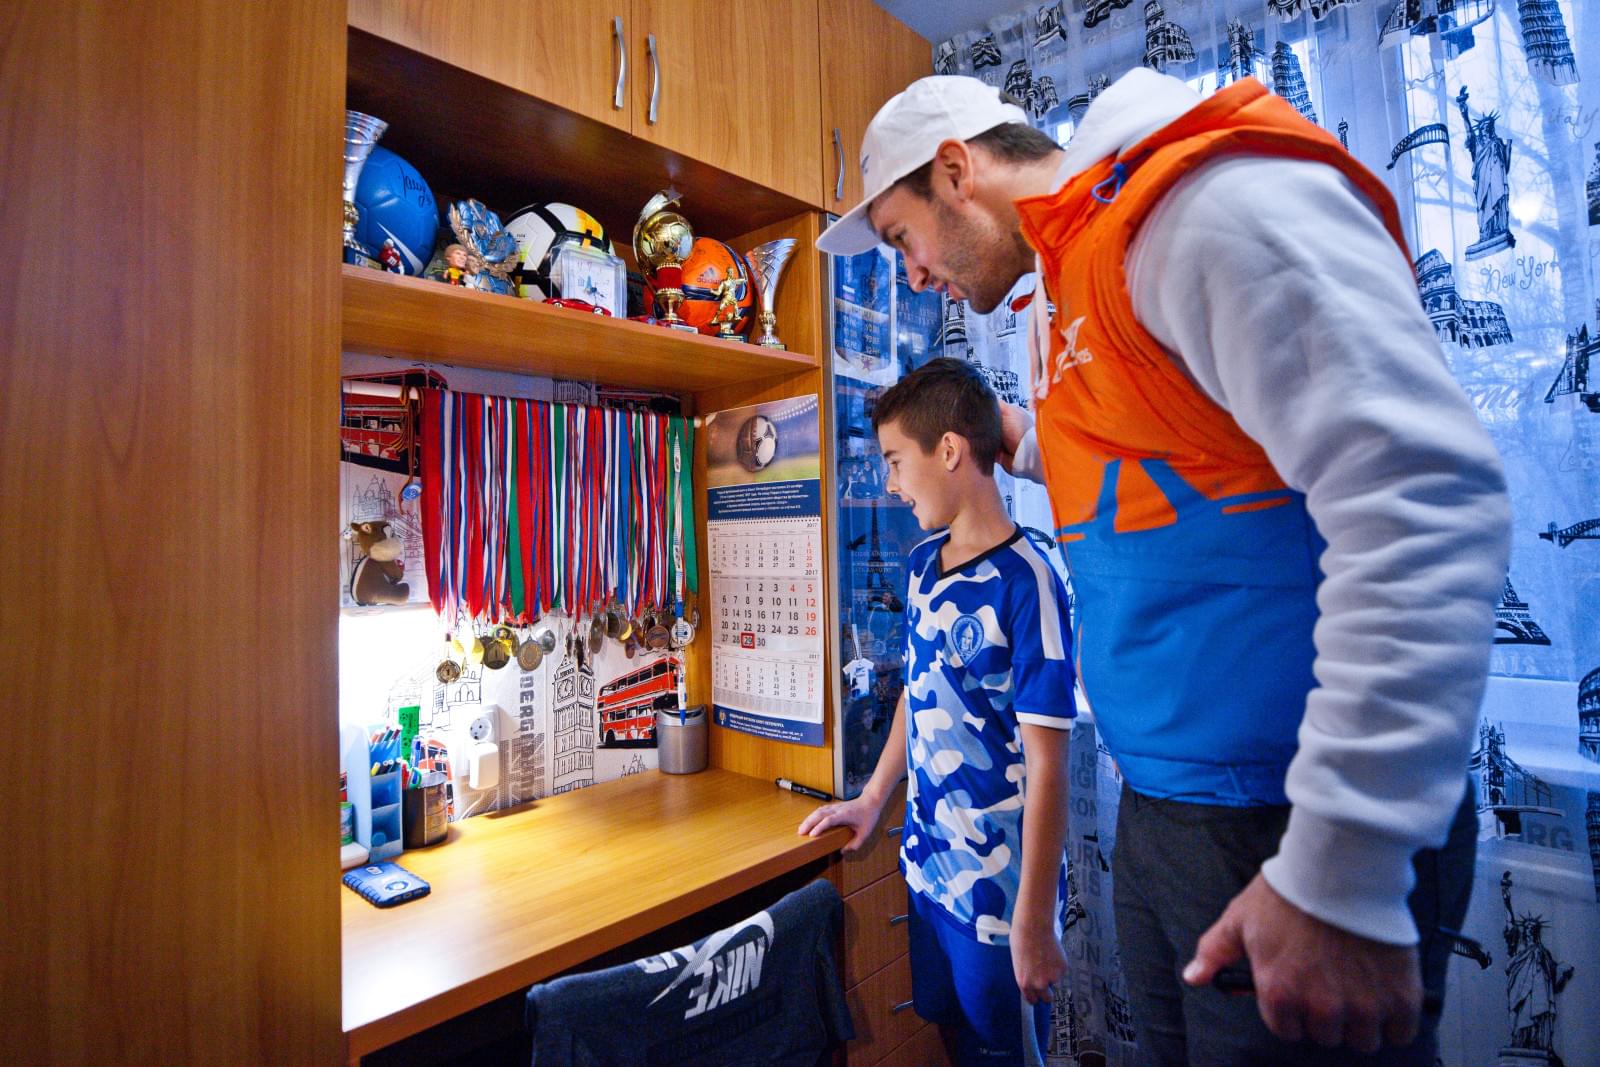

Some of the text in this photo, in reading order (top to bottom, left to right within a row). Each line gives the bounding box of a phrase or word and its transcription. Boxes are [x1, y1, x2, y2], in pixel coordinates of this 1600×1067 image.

[746, 583, 749, 591] 1
[759, 583, 763, 591] 2
[774, 584, 778, 592] 3
[808, 584, 813, 592] 5
[723, 595, 816, 607] 6 7 8 9 10 11 12
[722, 608, 816, 621] 13 14 15 16 17 18 19
[722, 621, 816, 636] 20 21 22 23 24 25 26
[722, 634, 766, 647] 27 28 29 30
[1526, 821, 1574, 851] RG
[684, 935, 766, 1020] NIKE
